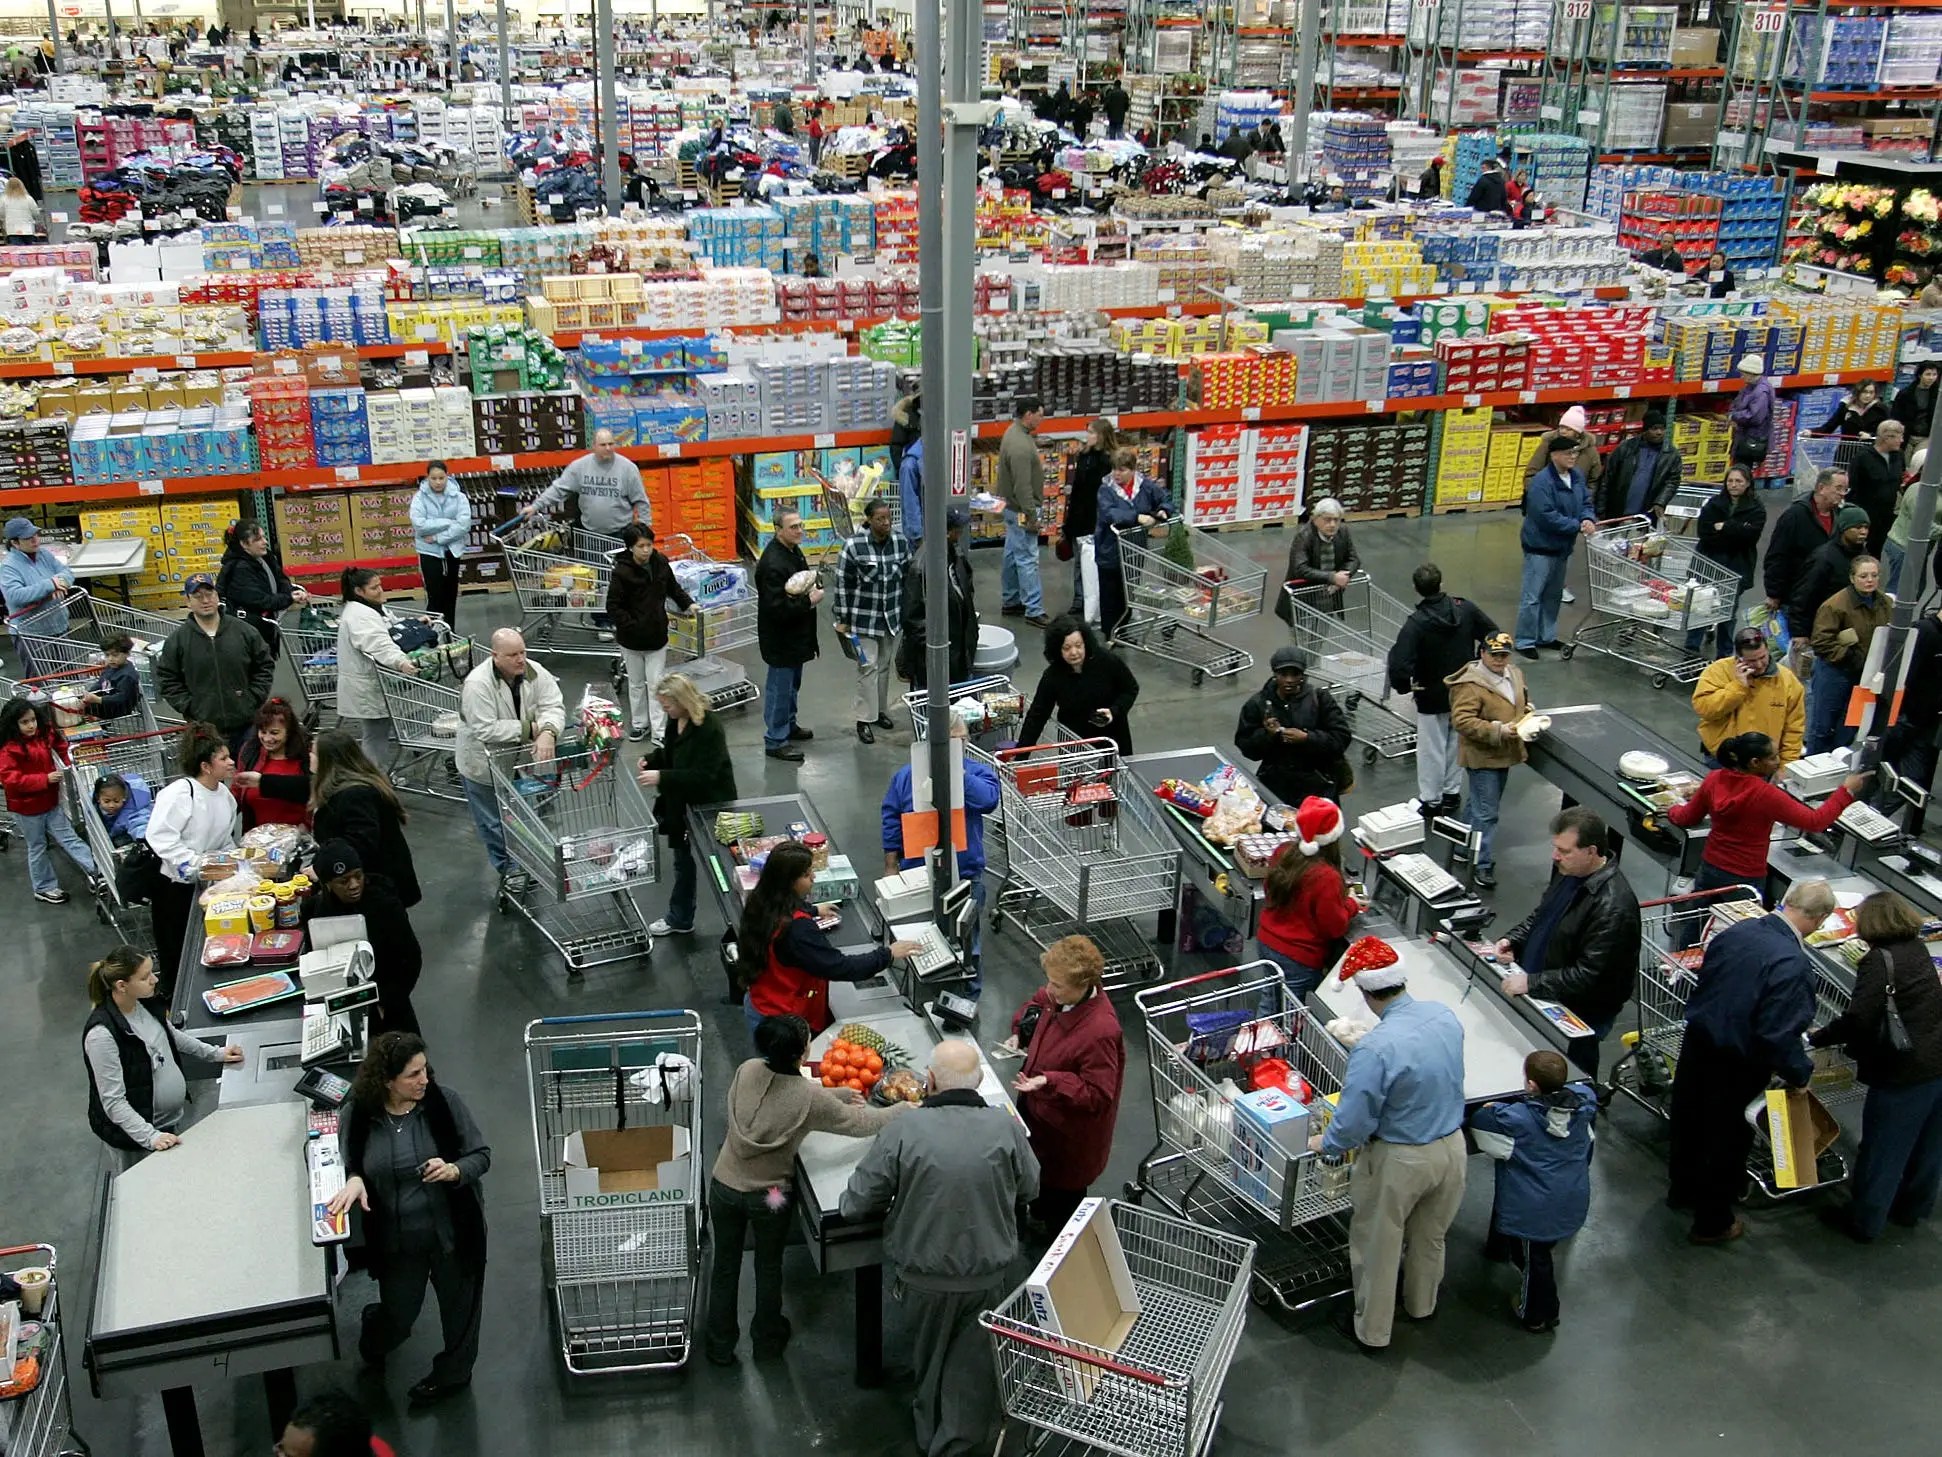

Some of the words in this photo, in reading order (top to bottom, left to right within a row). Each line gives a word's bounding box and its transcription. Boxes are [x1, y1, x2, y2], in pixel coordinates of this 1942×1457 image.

[1567, 3, 1588, 17] 312
[1755, 13, 1781, 31] 310
[583, 475, 618, 487] DALLAS
[581, 486, 620, 497] COWBOYS
[573, 1188, 684, 1207] TROPICLAND
[213, 1351, 230, 1377] 4
